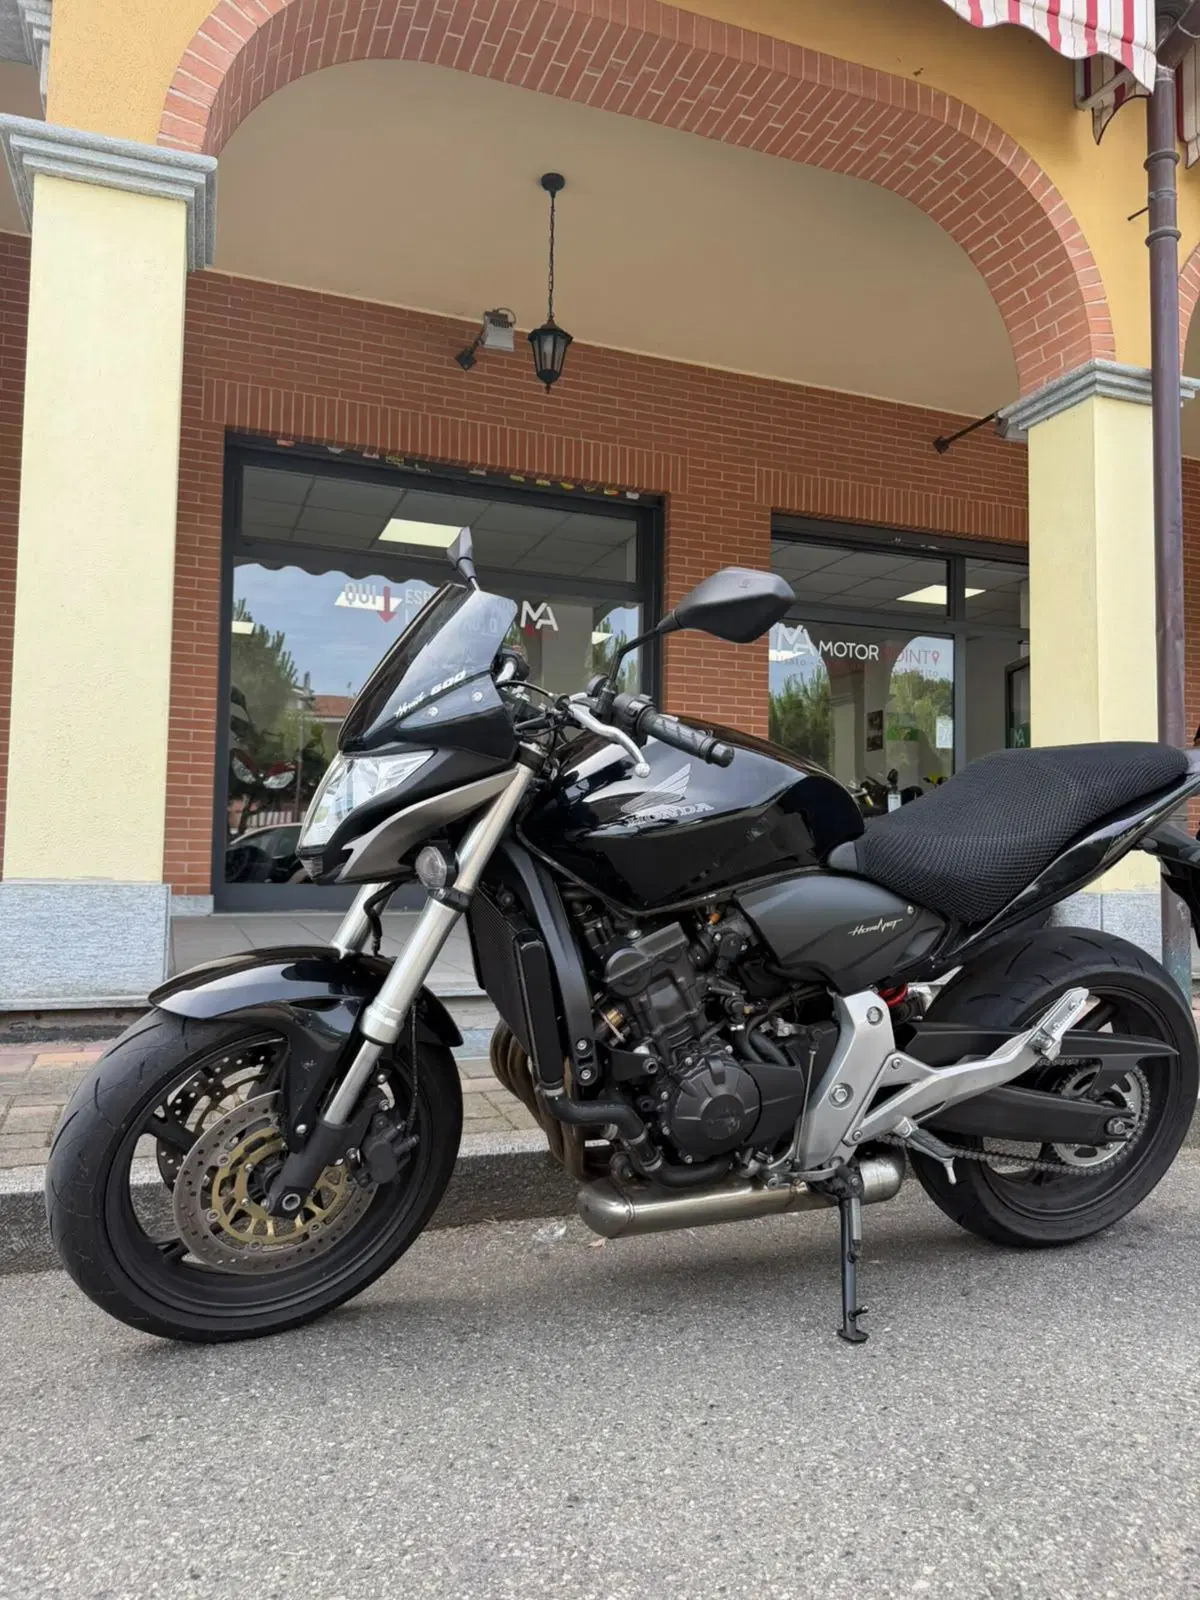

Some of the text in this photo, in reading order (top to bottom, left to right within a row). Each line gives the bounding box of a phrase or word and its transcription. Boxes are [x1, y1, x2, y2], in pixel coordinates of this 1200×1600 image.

[344, 582, 377, 605] QUI
[818, 640, 880, 661] MOTOR
[430, 669, 467, 696] 600
[627, 803, 715, 828] HONDA
